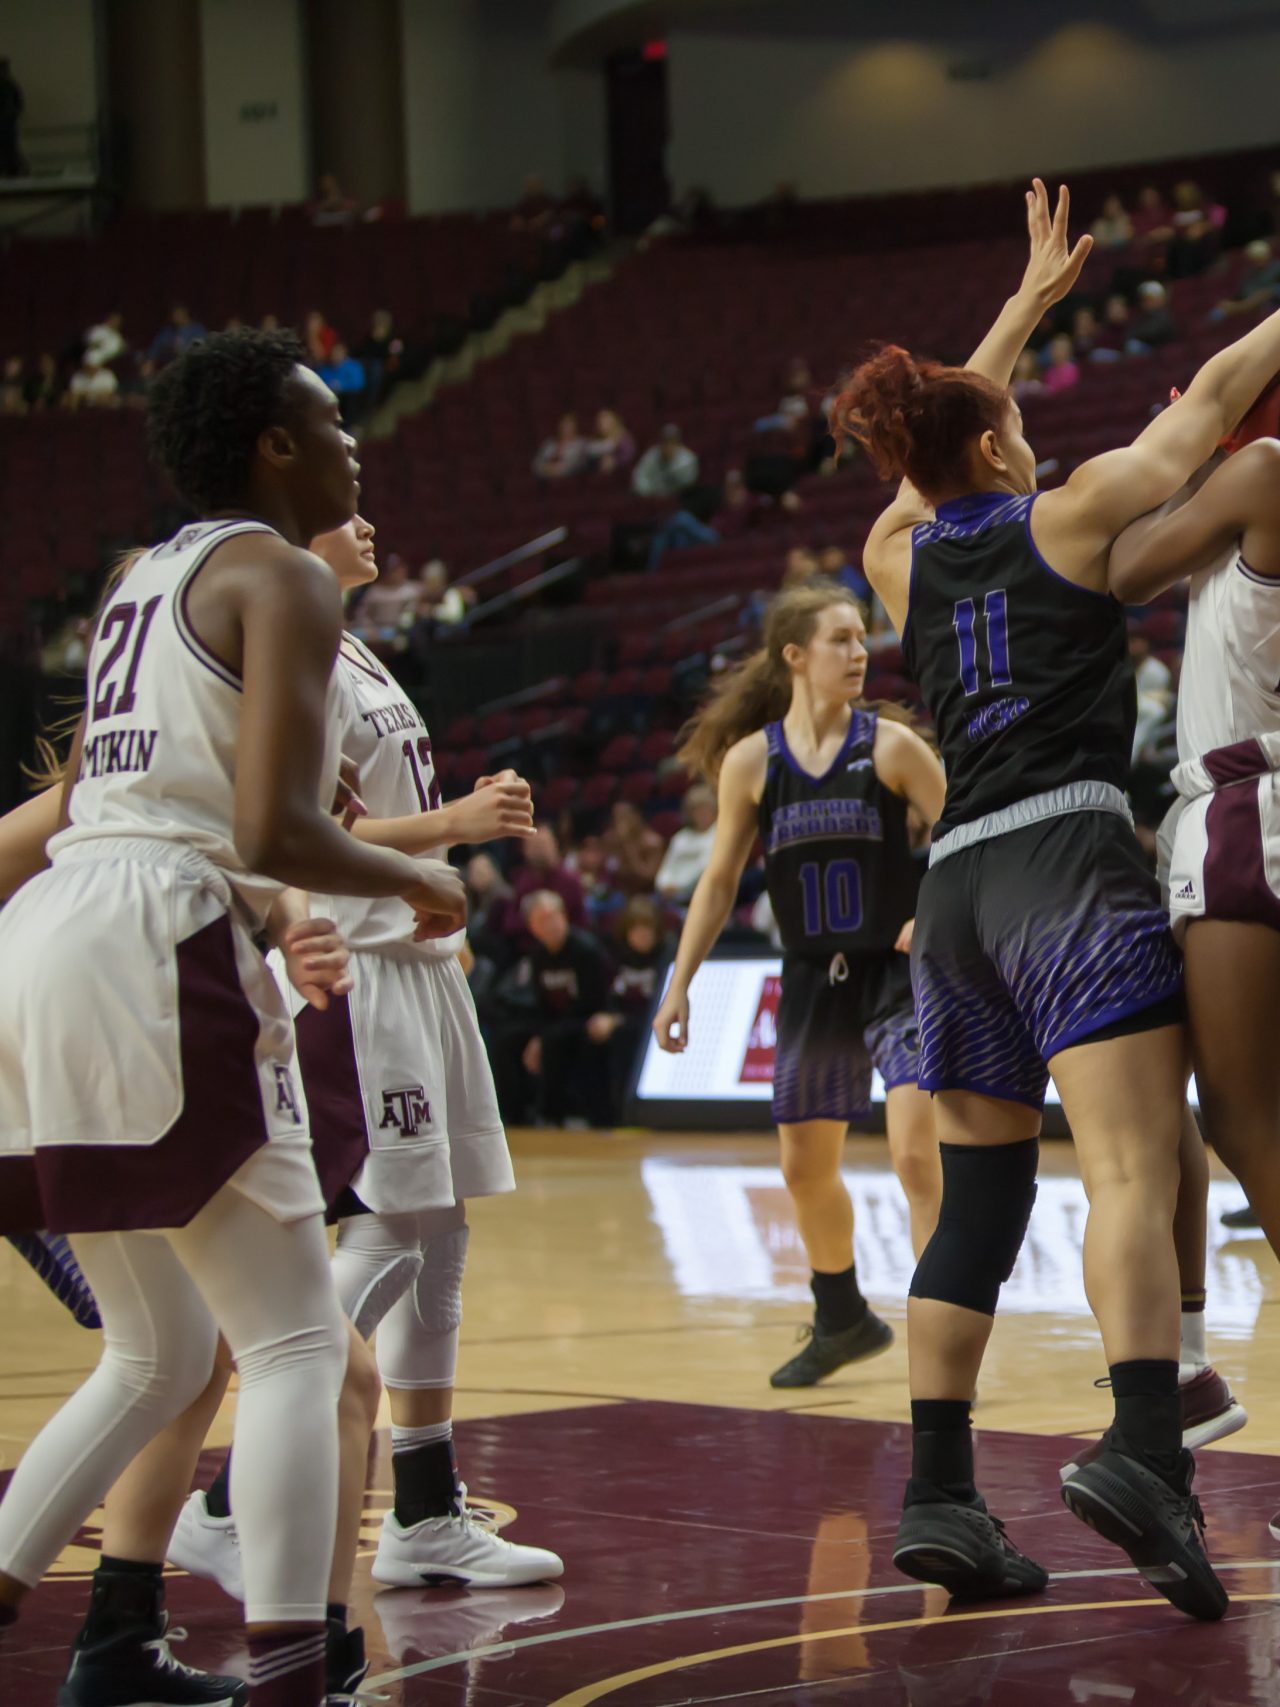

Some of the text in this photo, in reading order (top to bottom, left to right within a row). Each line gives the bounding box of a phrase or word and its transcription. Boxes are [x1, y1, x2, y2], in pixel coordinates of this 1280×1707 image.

[92, 594, 164, 723] 21
[952, 589, 1012, 697] 11
[361, 702, 416, 738] TEXAS
[799, 859, 863, 935] 10
